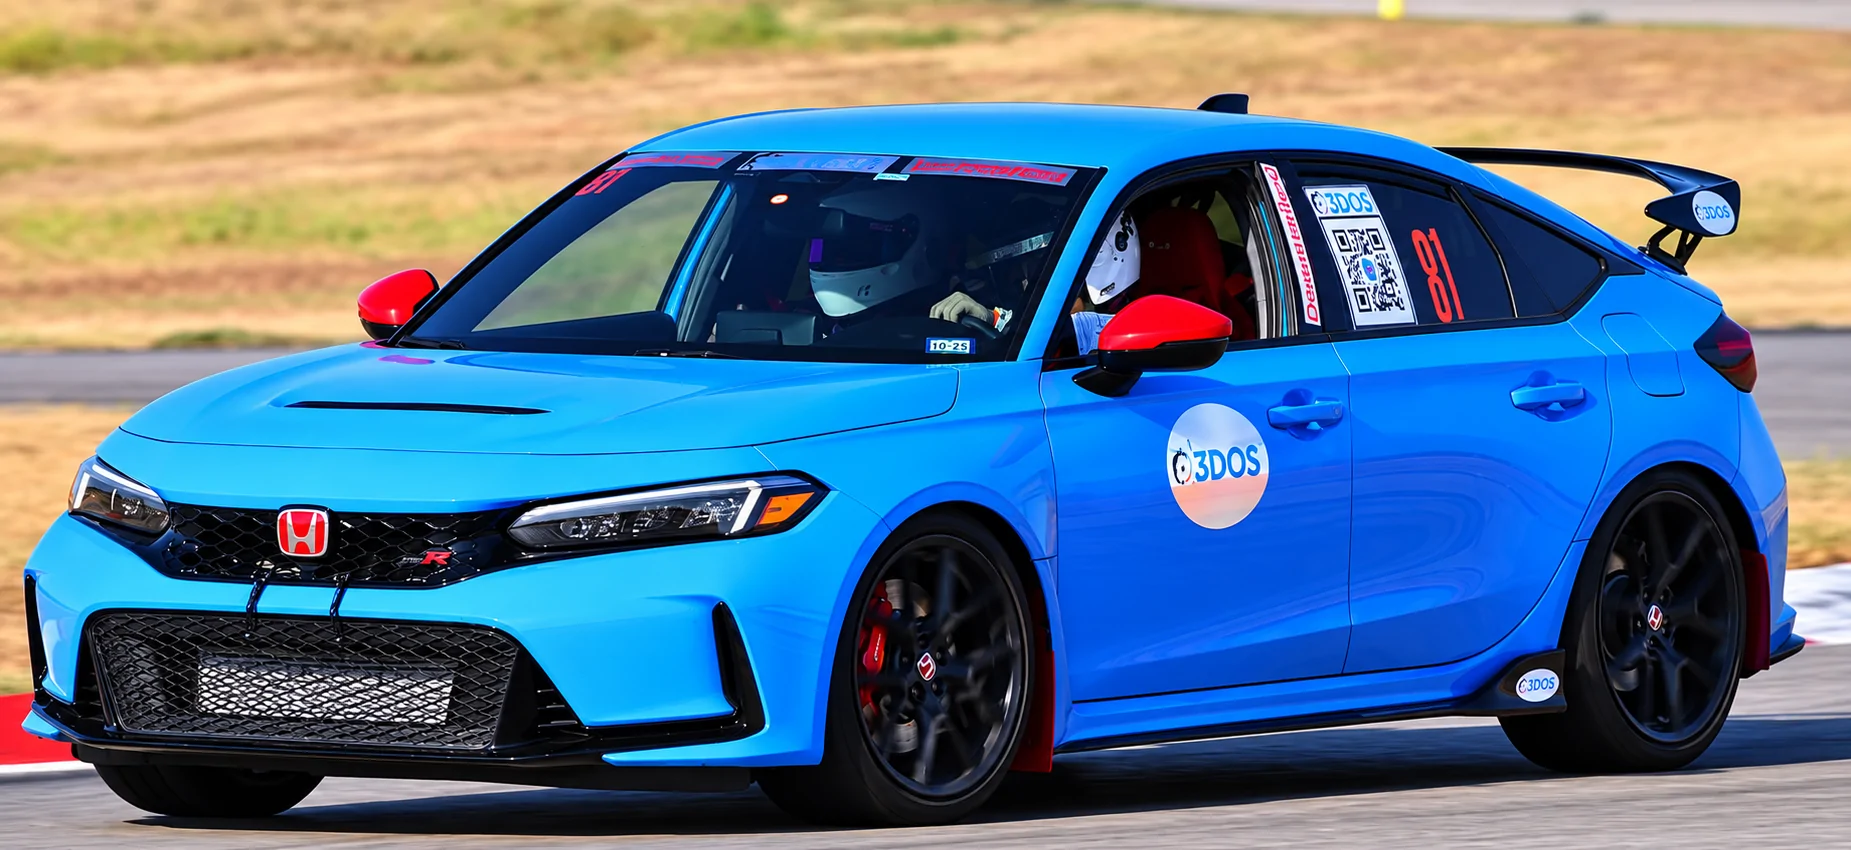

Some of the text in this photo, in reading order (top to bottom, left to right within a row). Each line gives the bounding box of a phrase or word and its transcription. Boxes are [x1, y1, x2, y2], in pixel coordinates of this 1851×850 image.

[575, 167, 632, 196] 81
[1325, 191, 1373, 214] 3DOS
[1703, 204, 1730, 219] 3DOS
[1411, 227, 1465, 324] 81
[1193, 444, 1261, 482] 3DOS
[1527, 677, 1555, 692] 3DOS
